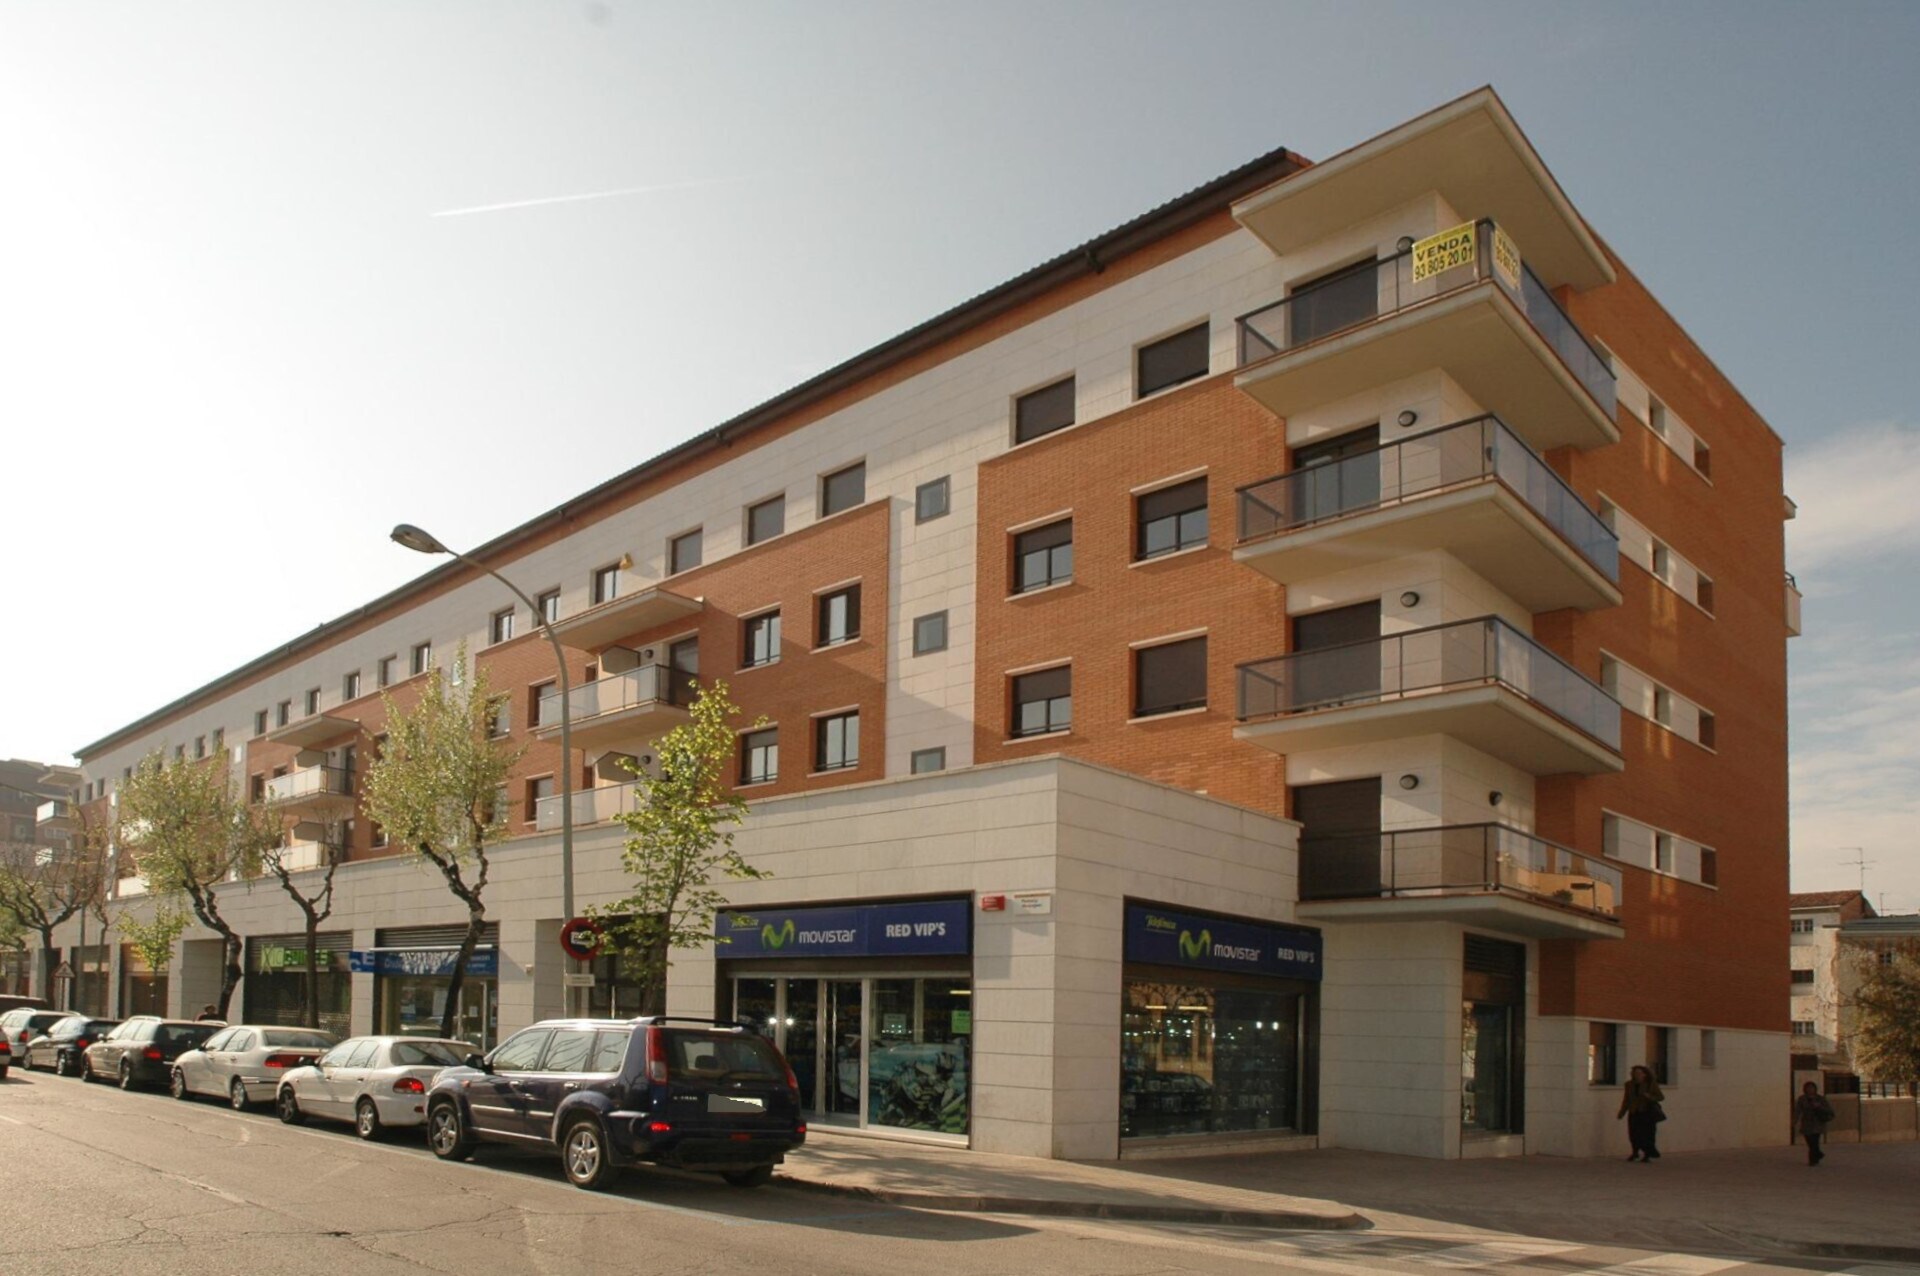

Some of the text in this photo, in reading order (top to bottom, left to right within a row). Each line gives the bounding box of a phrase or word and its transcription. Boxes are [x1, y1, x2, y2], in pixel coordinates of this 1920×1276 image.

[1416, 234, 1470, 262] VENDA
[1415, 246, 1473, 280] 93 805 20 01
[886, 922, 946, 937] RED VIP'S
[1277, 947, 1295, 961] RED
